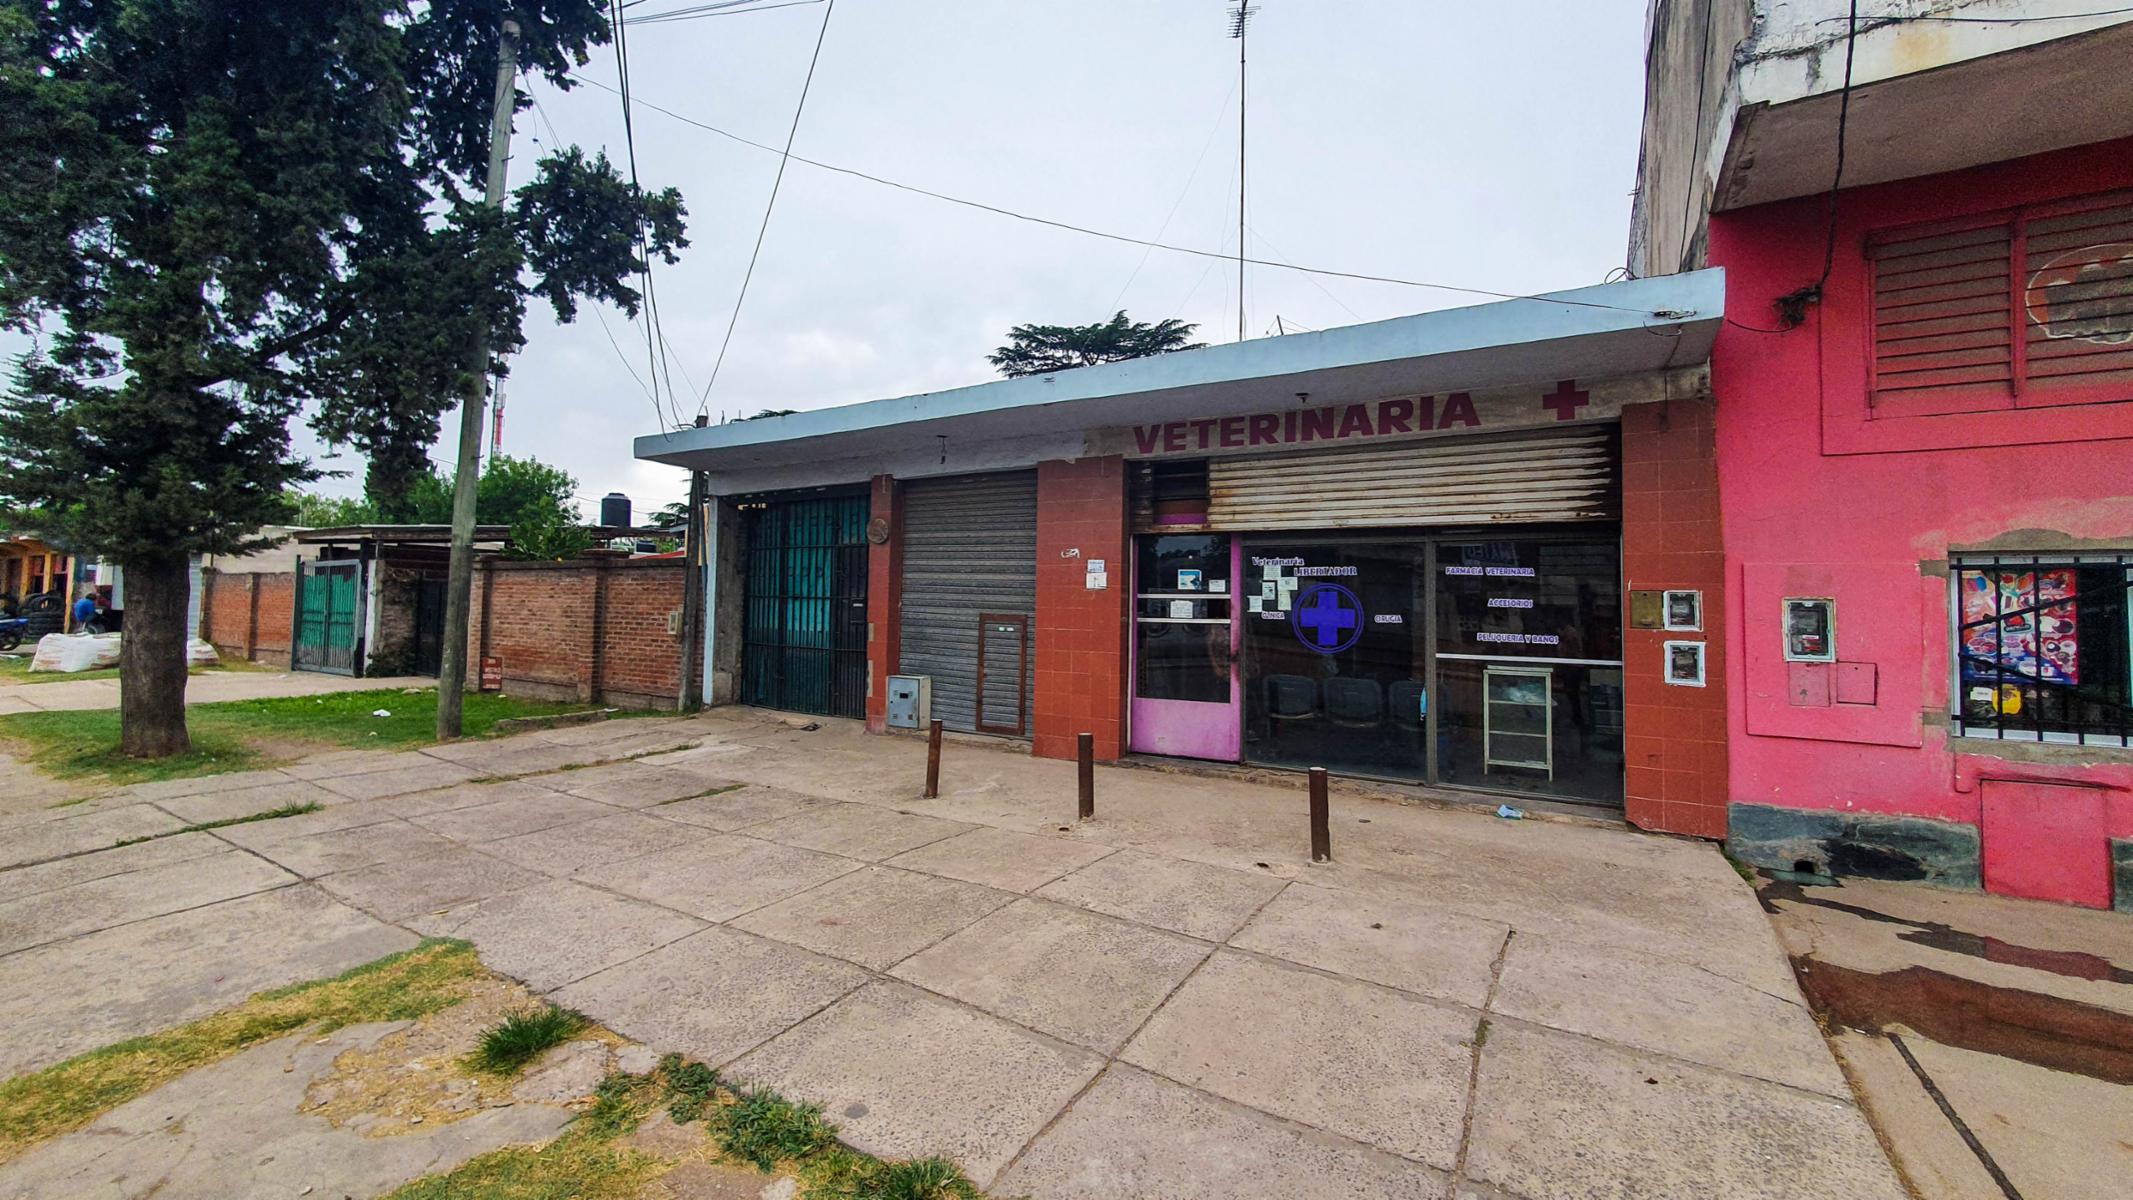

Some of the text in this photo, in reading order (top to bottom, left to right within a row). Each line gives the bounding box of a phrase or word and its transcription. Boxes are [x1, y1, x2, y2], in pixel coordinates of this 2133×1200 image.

[1133, 392, 1481, 454] VETERINARIA
[1251, 556, 1305, 566] Veterinaria
[1293, 566, 1358, 576] LIBERTADOR
[1445, 567, 1535, 576] FARMACIA VETERINARIA
[1487, 598, 1534, 608] ACCESORIOS
[1476, 632, 1524, 643] PELUQUERIA
[1524, 635, 1532, 643] Y
